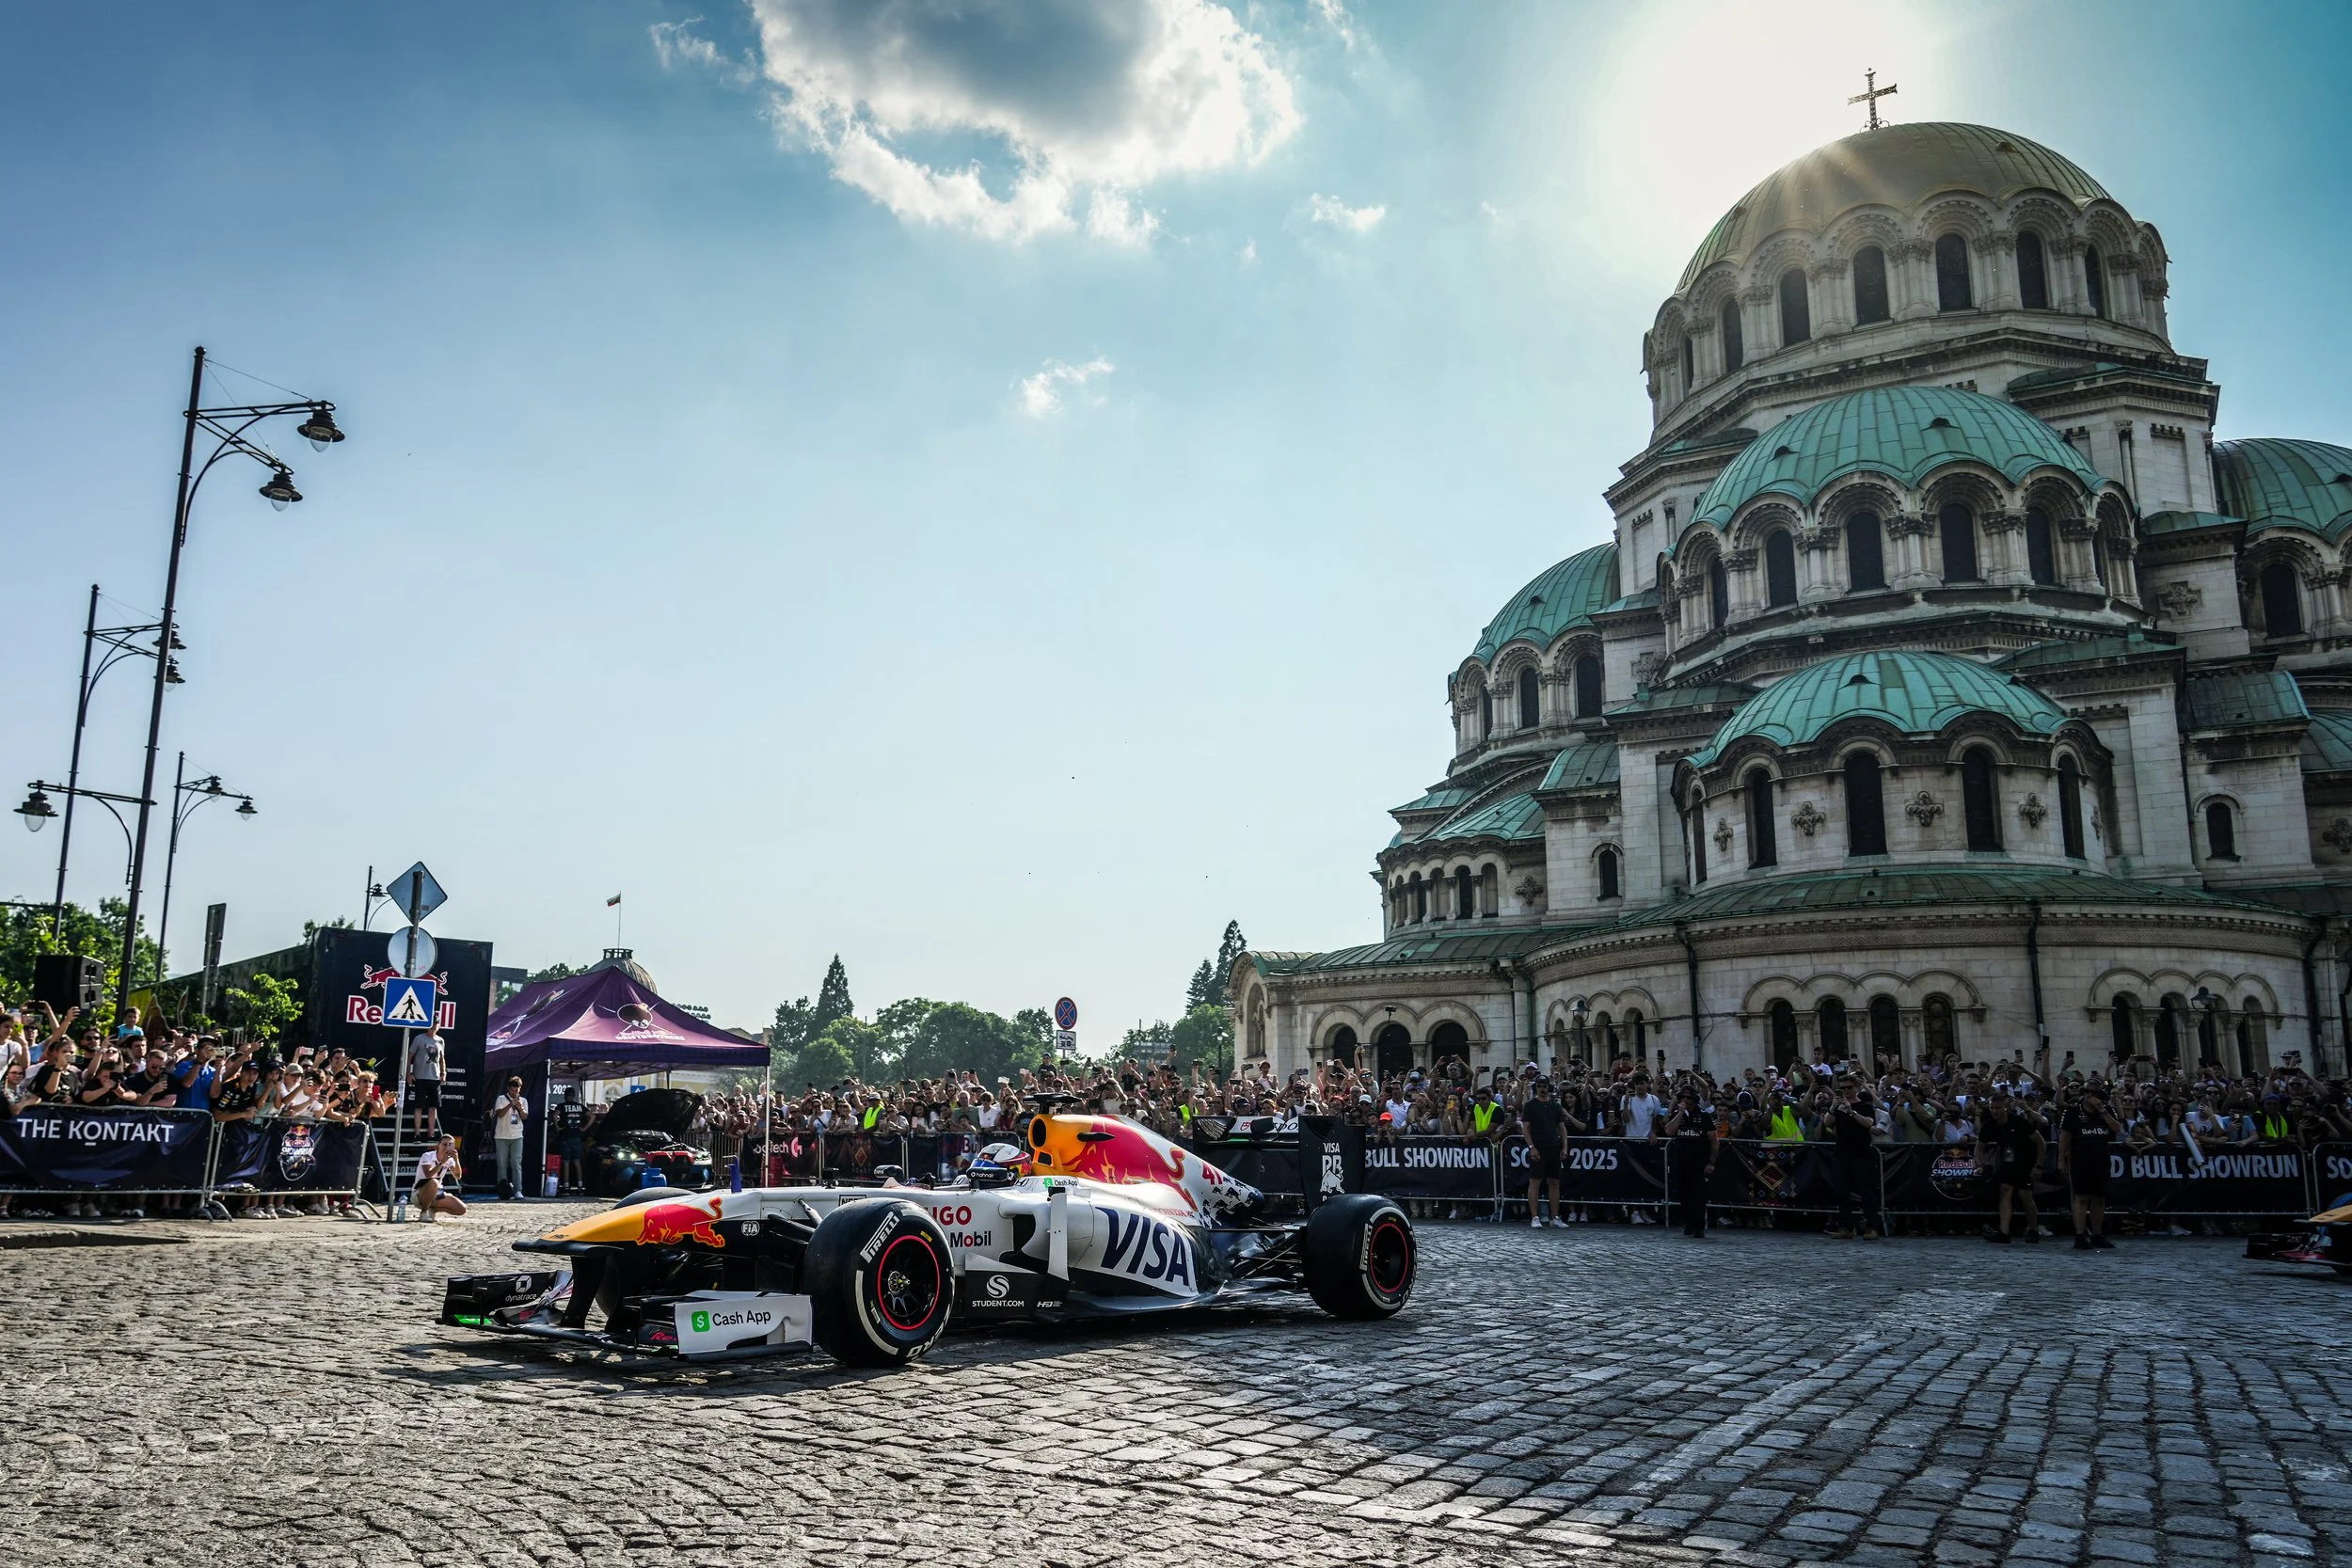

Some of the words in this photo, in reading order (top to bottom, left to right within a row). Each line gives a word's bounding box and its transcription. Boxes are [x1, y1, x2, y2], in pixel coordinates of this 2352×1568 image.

[346, 995, 383, 1025] Re
[552, 1085, 571, 1095] 202
[564, 1104, 583, 1113] TEAM
[17, 1118, 62, 1138] THE
[68, 1120, 175, 1146] KONTAKT
[1323, 1142, 1341, 1153] VISA
[1364, 1148, 1400, 1168] BULL
[1403, 1147, 1490, 1168] SHOWRUN
[1568, 1148, 1618, 1170] 2025
[2131, 1155, 2183, 1179] BULL
[2187, 1154, 2299, 1180] SHOWRUN
[924, 1205, 972, 1227] GO
[859, 1211, 900, 1264] PIRELLI
[949, 1230, 992, 1248] Mobil
[1094, 1206, 1193, 1288] VISA
[504, 1293, 537, 1303] dynatrace
[712, 1311, 744, 1327] Cash
[746, 1309, 771, 1325] App
